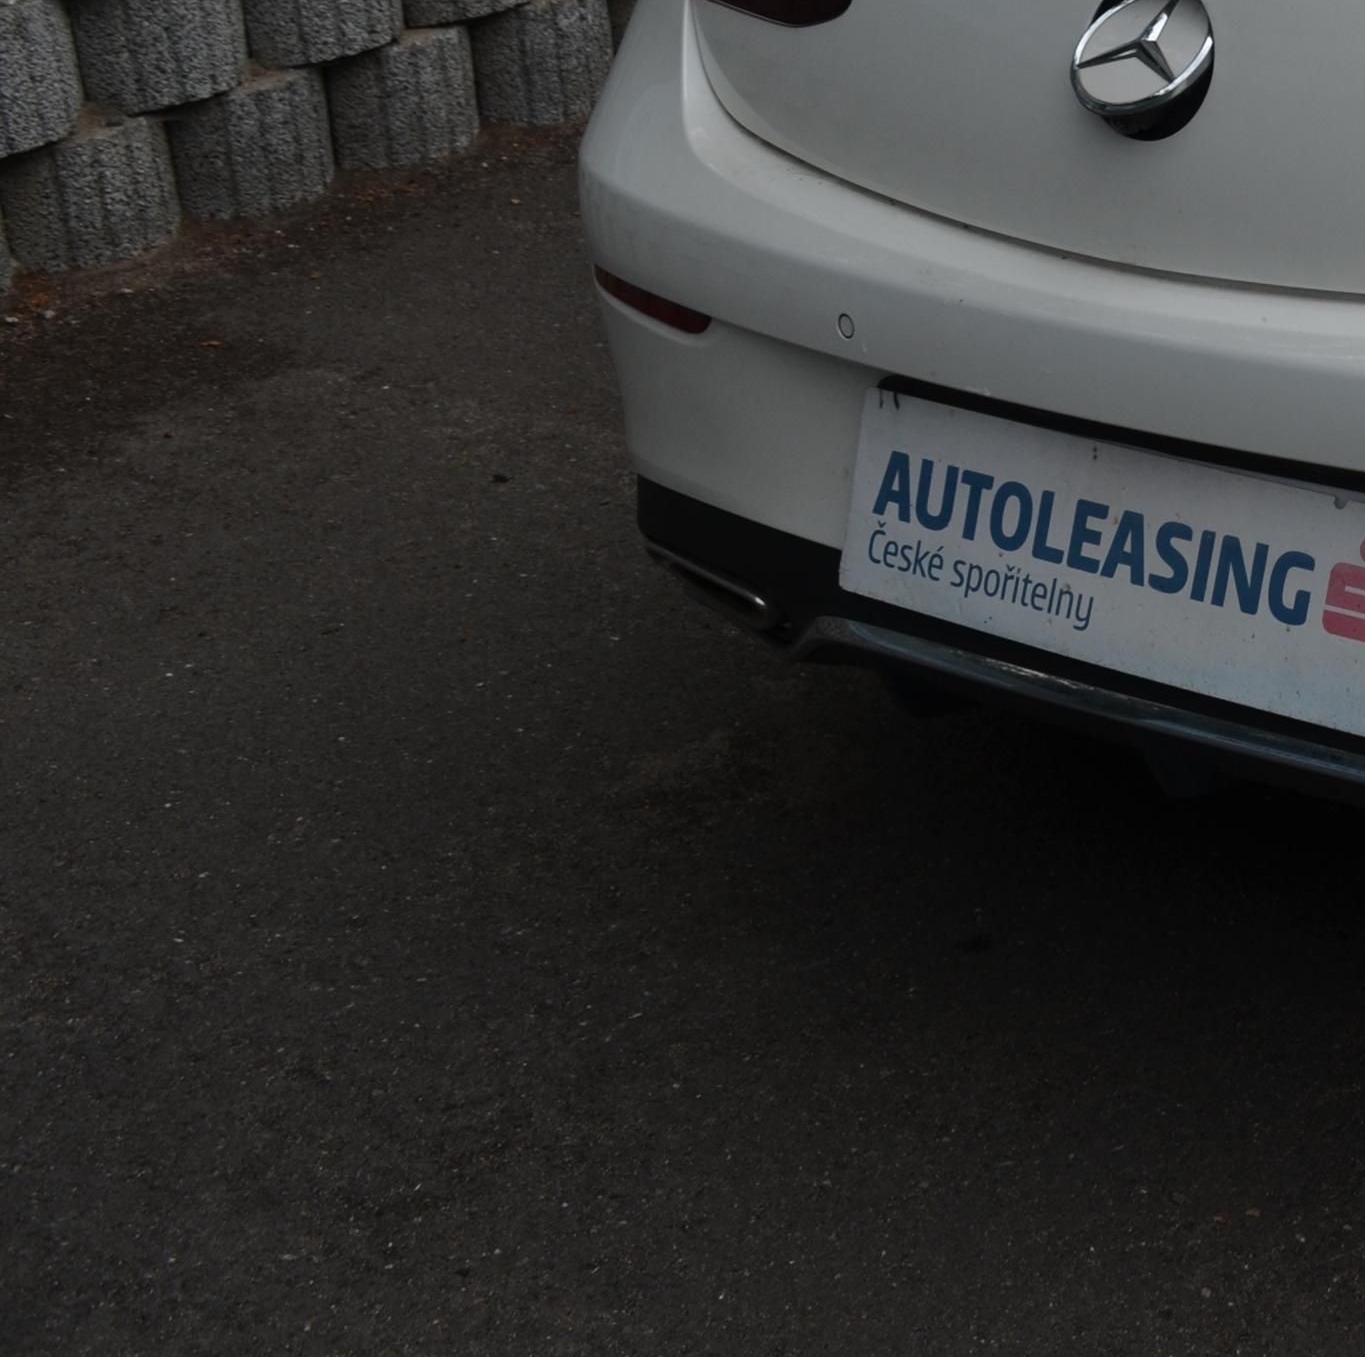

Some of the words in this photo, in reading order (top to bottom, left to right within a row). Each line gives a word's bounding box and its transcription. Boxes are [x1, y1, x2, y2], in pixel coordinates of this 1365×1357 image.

[868, 520, 944, 582] České
[950, 559, 1094, 632] spořitelny
[872, 450, 1316, 626] AUTOLEASING
